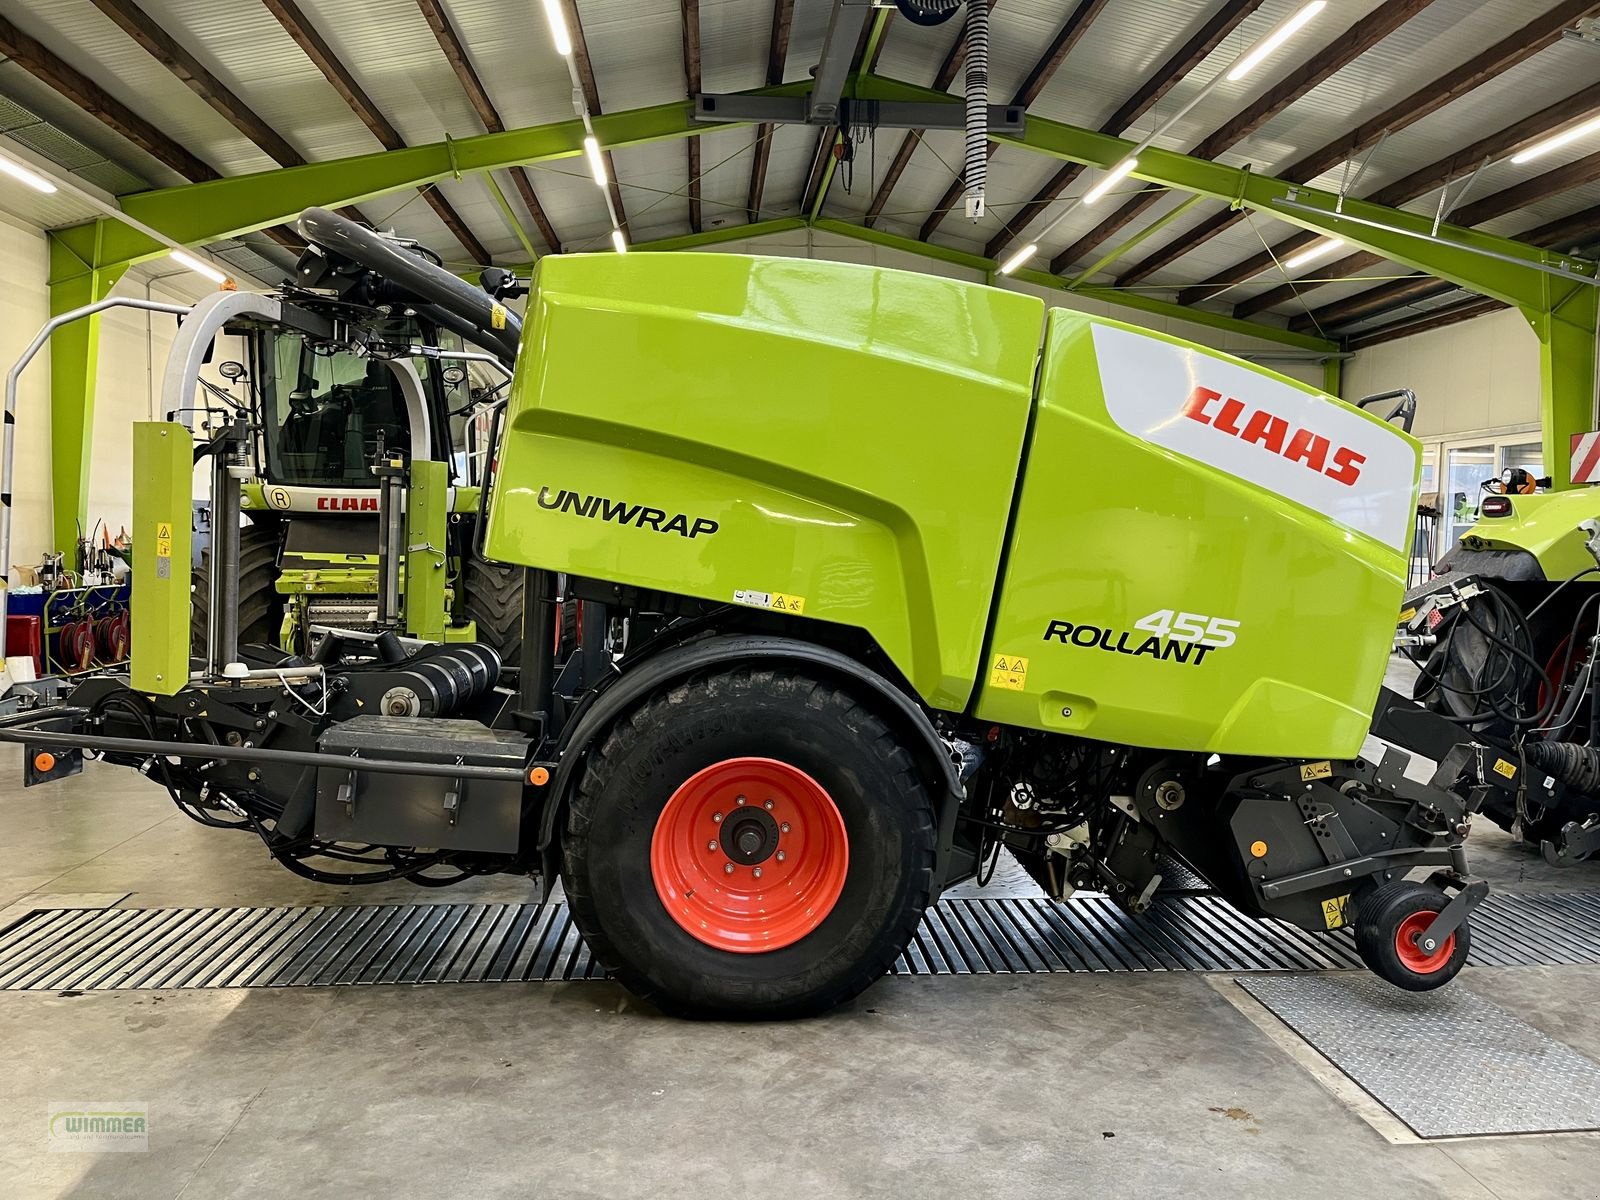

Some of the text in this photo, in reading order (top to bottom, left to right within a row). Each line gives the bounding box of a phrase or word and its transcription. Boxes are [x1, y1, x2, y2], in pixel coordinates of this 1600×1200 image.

[1184, 386, 1367, 486] CLAAS
[317, 497, 381, 511] CLAA
[537, 486, 719, 538] UNIWRAP
[1043, 620, 1216, 666] ROLLANT
[1134, 609, 1240, 647] 455
